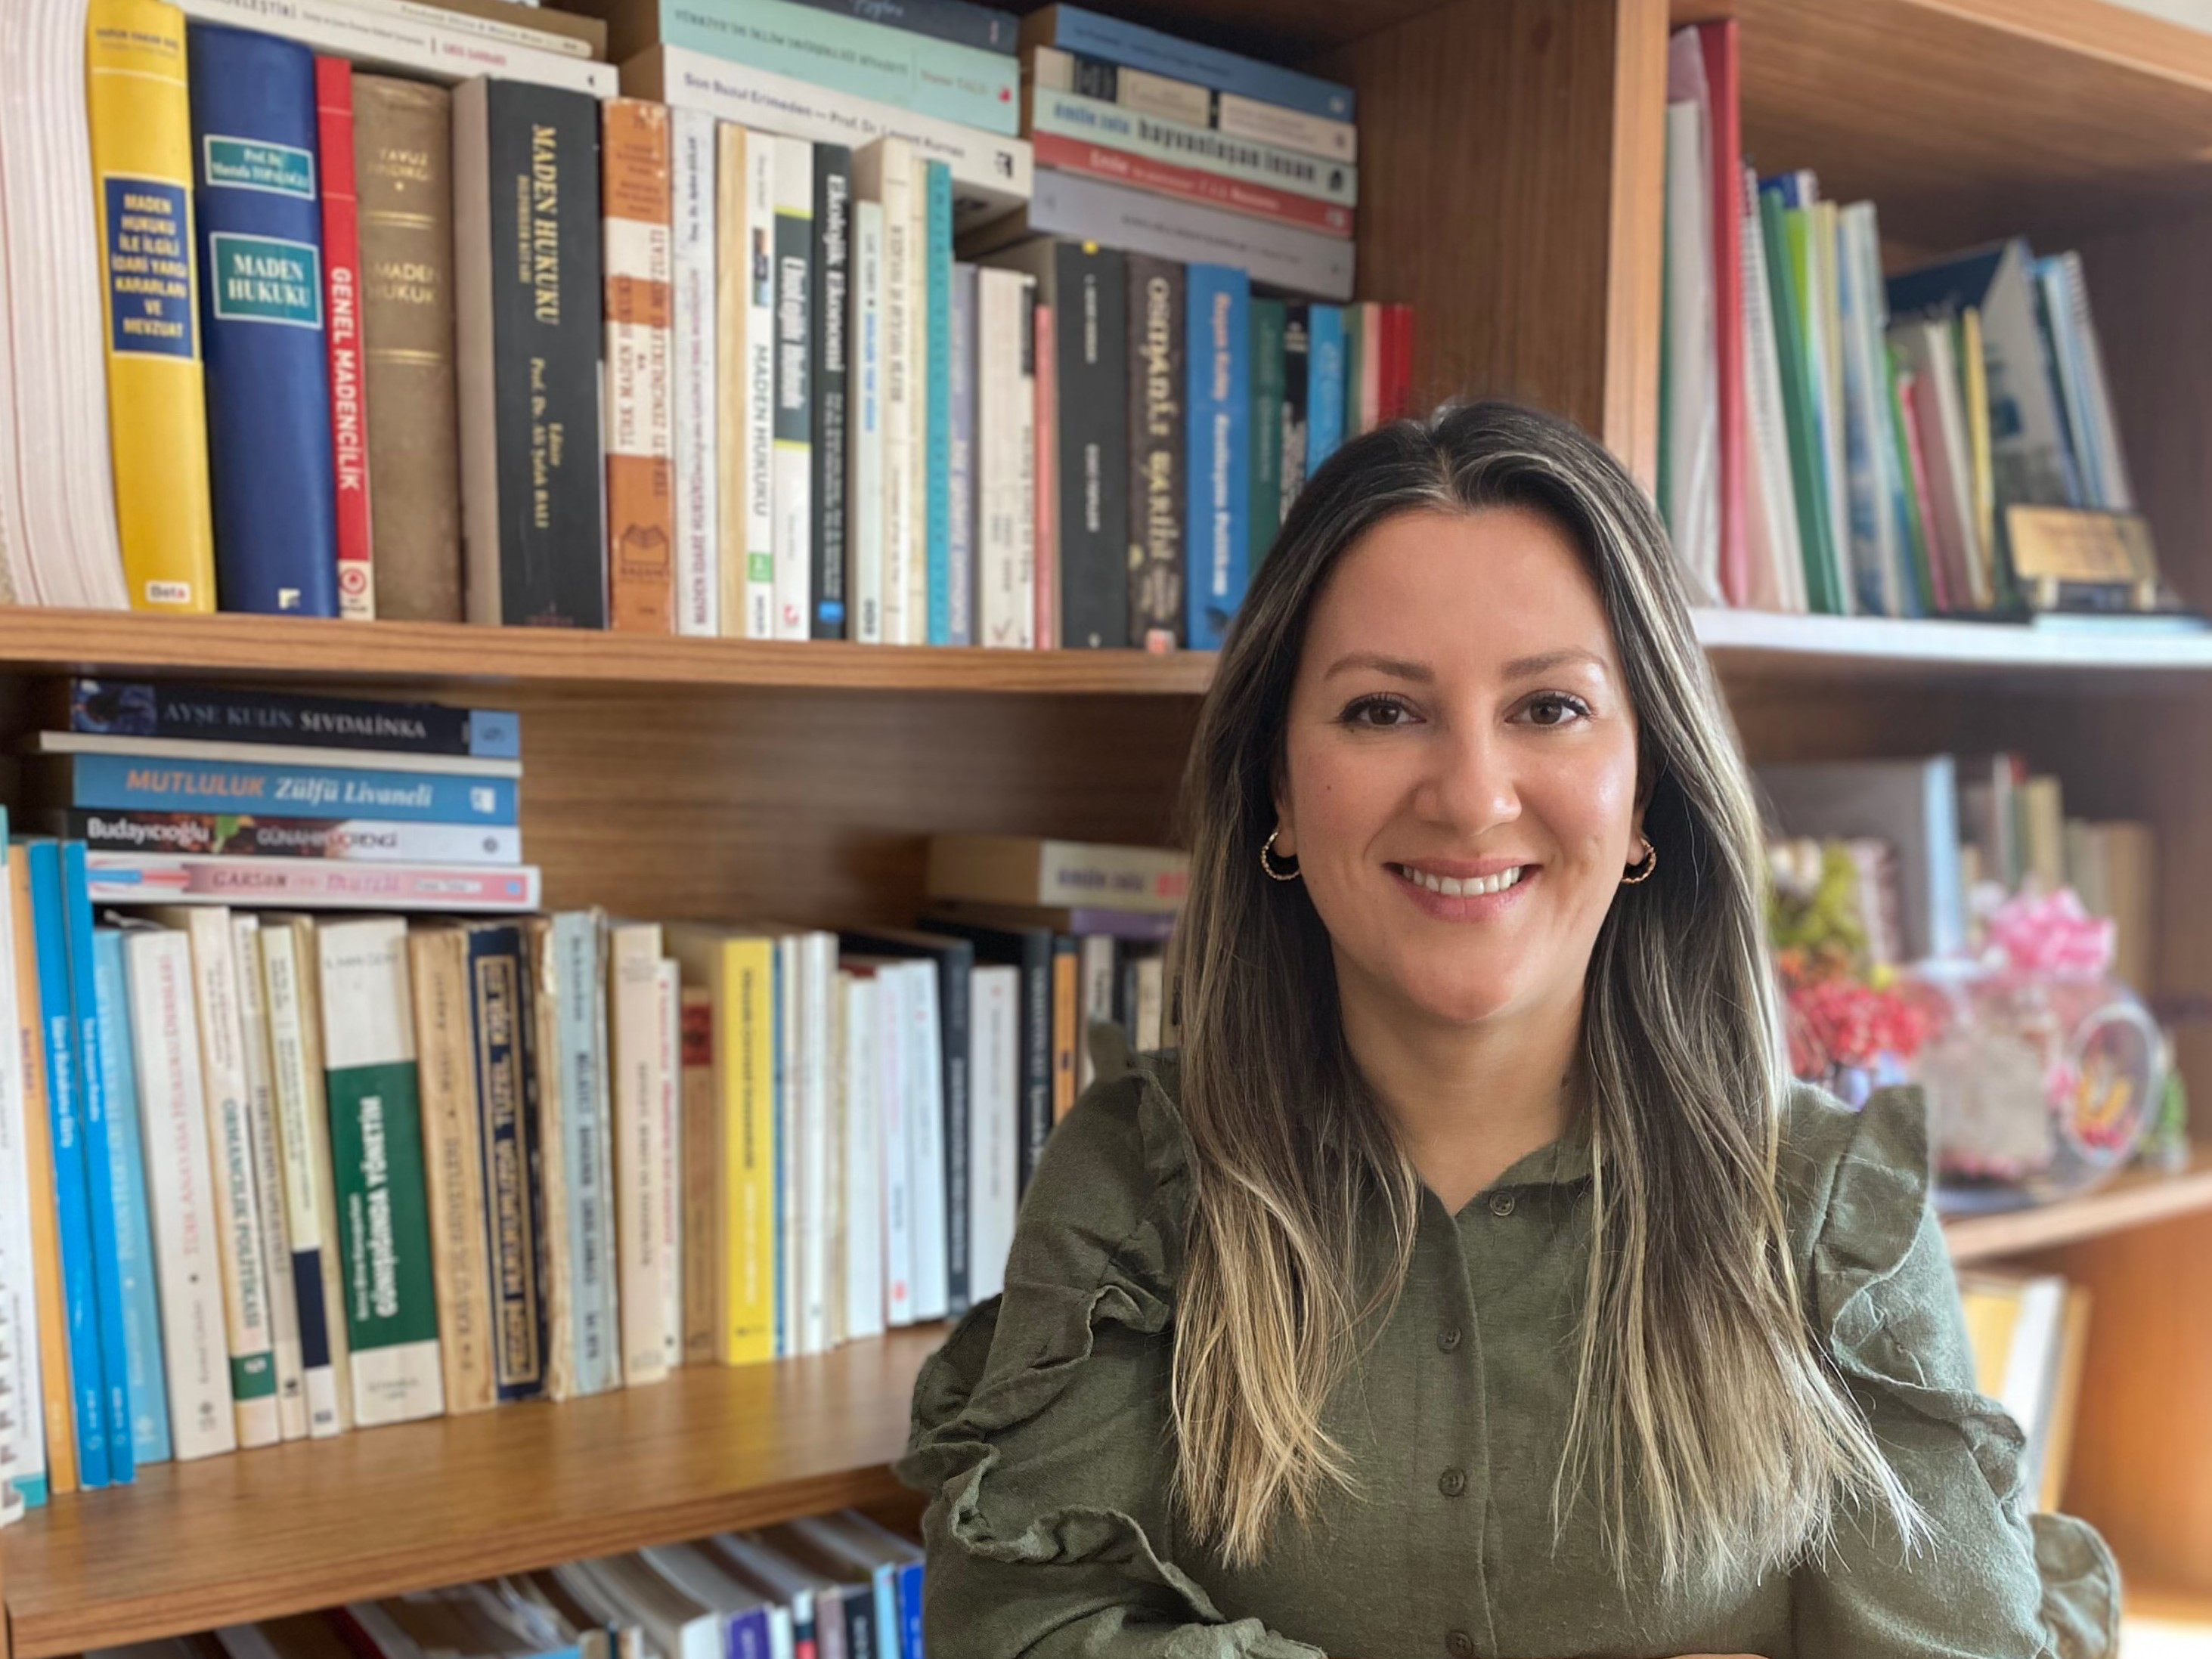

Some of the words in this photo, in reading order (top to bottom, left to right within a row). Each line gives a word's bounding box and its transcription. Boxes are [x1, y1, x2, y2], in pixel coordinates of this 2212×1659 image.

[684, 72, 711, 92] Son
[713, 78, 748, 101] Buzul
[751, 88, 813, 116] Erimeden
[829, 111, 860, 134] Prof.
[532, 124, 559, 215] MADEN
[120, 214, 177, 237] HUKUKU
[123, 193, 172, 215] MADEN
[823, 174, 847, 266] Ekolojik
[119, 233, 140, 253] İLE
[232, 252, 305, 282] MADEN
[533, 218, 560, 326] HUKUKU
[144, 299, 163, 317] VE
[228, 277, 311, 309] HUKUKU
[331, 266, 354, 344] GENEL
[826, 270, 846, 372] Ekonomi
[617, 345, 636, 399] MADEN
[754, 343, 770, 421] MADEN
[334, 348, 361, 491] MADENCİLİK
[618, 405, 637, 447] TÜRK
[753, 426, 770, 517] HUKUKU
[163, 700, 215, 727] AYŞE
[227, 704, 294, 731] KULİN
[299, 707, 426, 740] SEVDALİNKA
[125, 769, 267, 799] MUTLULUK
[274, 777, 339, 802] Zülfü
[342, 778, 435, 809] Livaneli
[86, 816, 210, 847] Budayıcıoğlu
[221, 1098, 251, 1219] ORMANCILIK
[358, 1095, 389, 1187] YÖNETİM
[234, 1223, 262, 1329] POLİTİKASI
